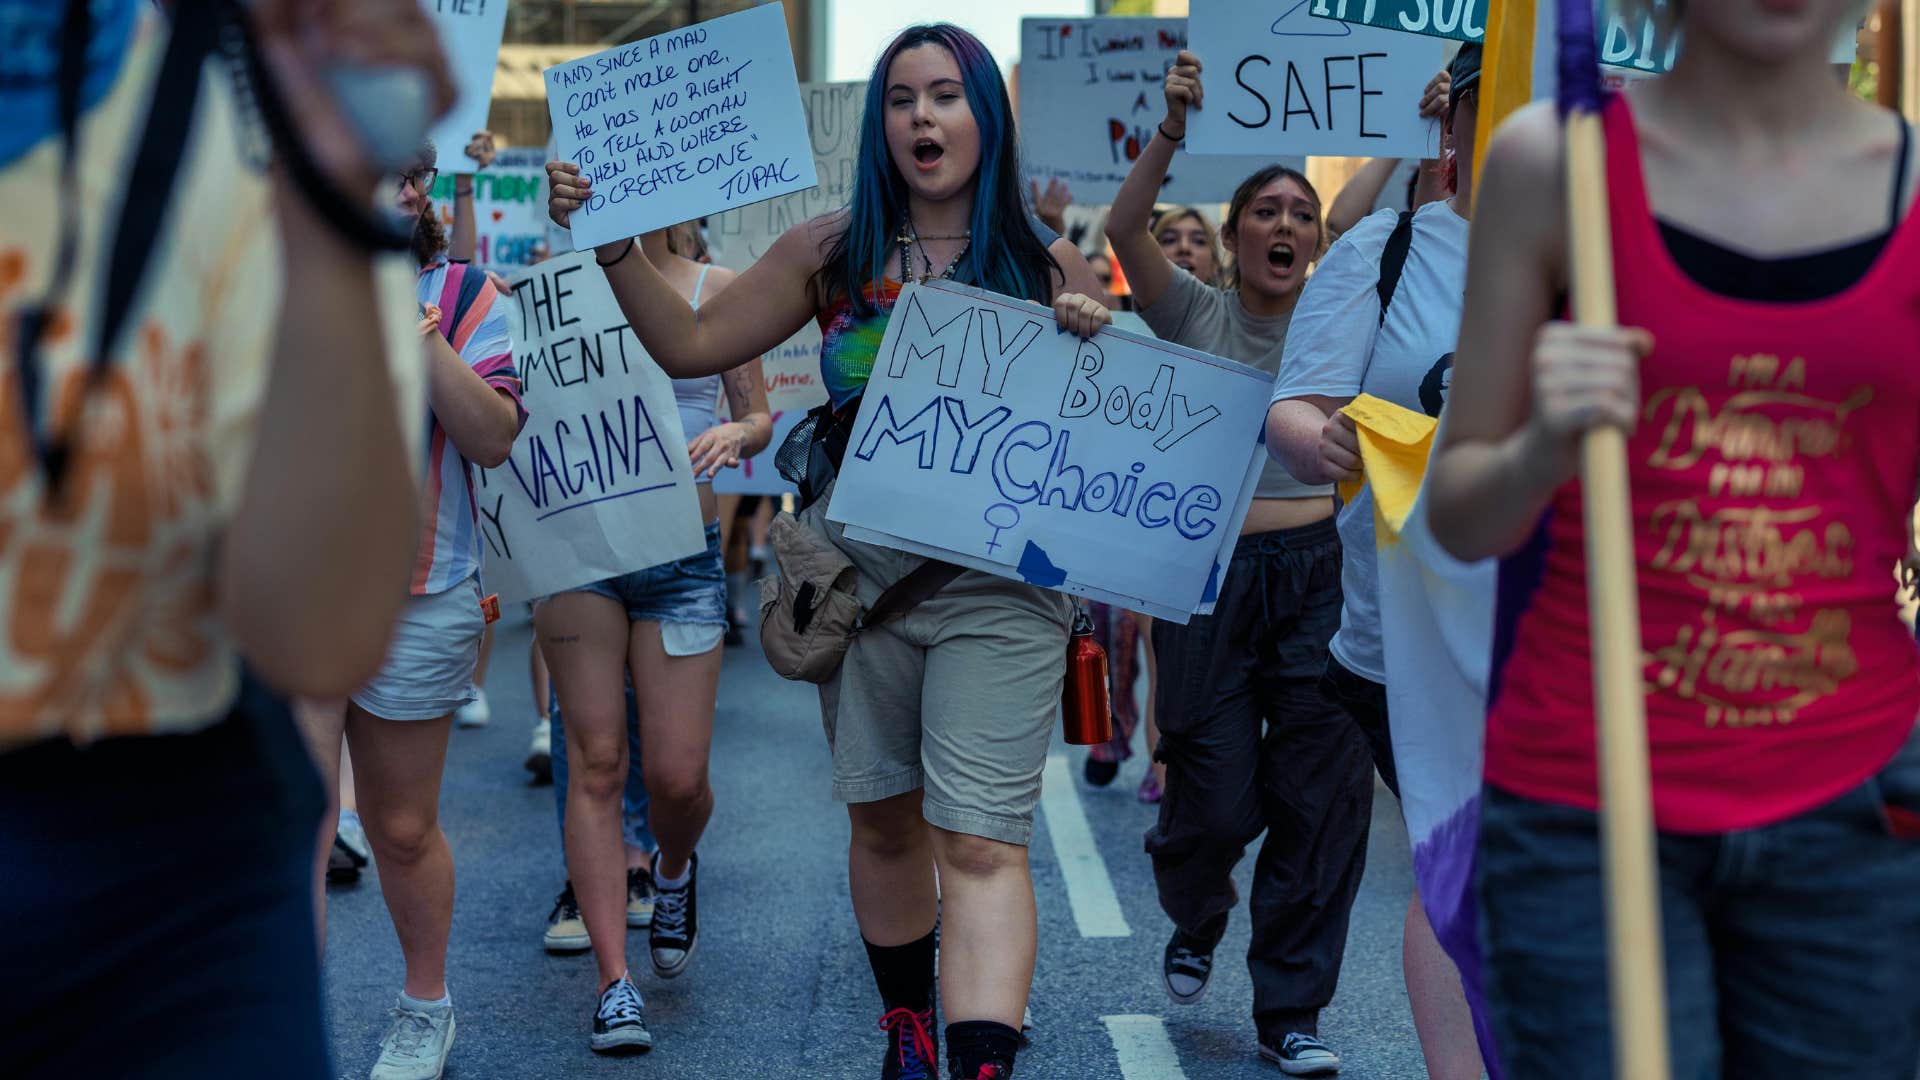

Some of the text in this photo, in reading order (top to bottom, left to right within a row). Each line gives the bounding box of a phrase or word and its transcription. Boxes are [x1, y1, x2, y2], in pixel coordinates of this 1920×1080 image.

[596, 46, 643, 76] SINCE
[649, 38, 660, 59] A
[667, 28, 707, 53] MAN
[575, 59, 753, 141] He has NO RIGHT
[1227, 52, 1388, 138] SAFE
[572, 145, 595, 169] TO
[603, 132, 647, 157] TELL
[654, 119, 665, 139] A
[636, 141, 675, 166] AND
[681, 115, 748, 152] WHERE
[718, 157, 800, 201] TUPAC
[609, 161, 695, 204] CREATE
[510, 264, 582, 342] THE
[888, 291, 1222, 452] MY Body
[508, 395, 674, 509] VAGINA
[855, 395, 1012, 475] MY
[991, 420, 1222, 541] Choice
